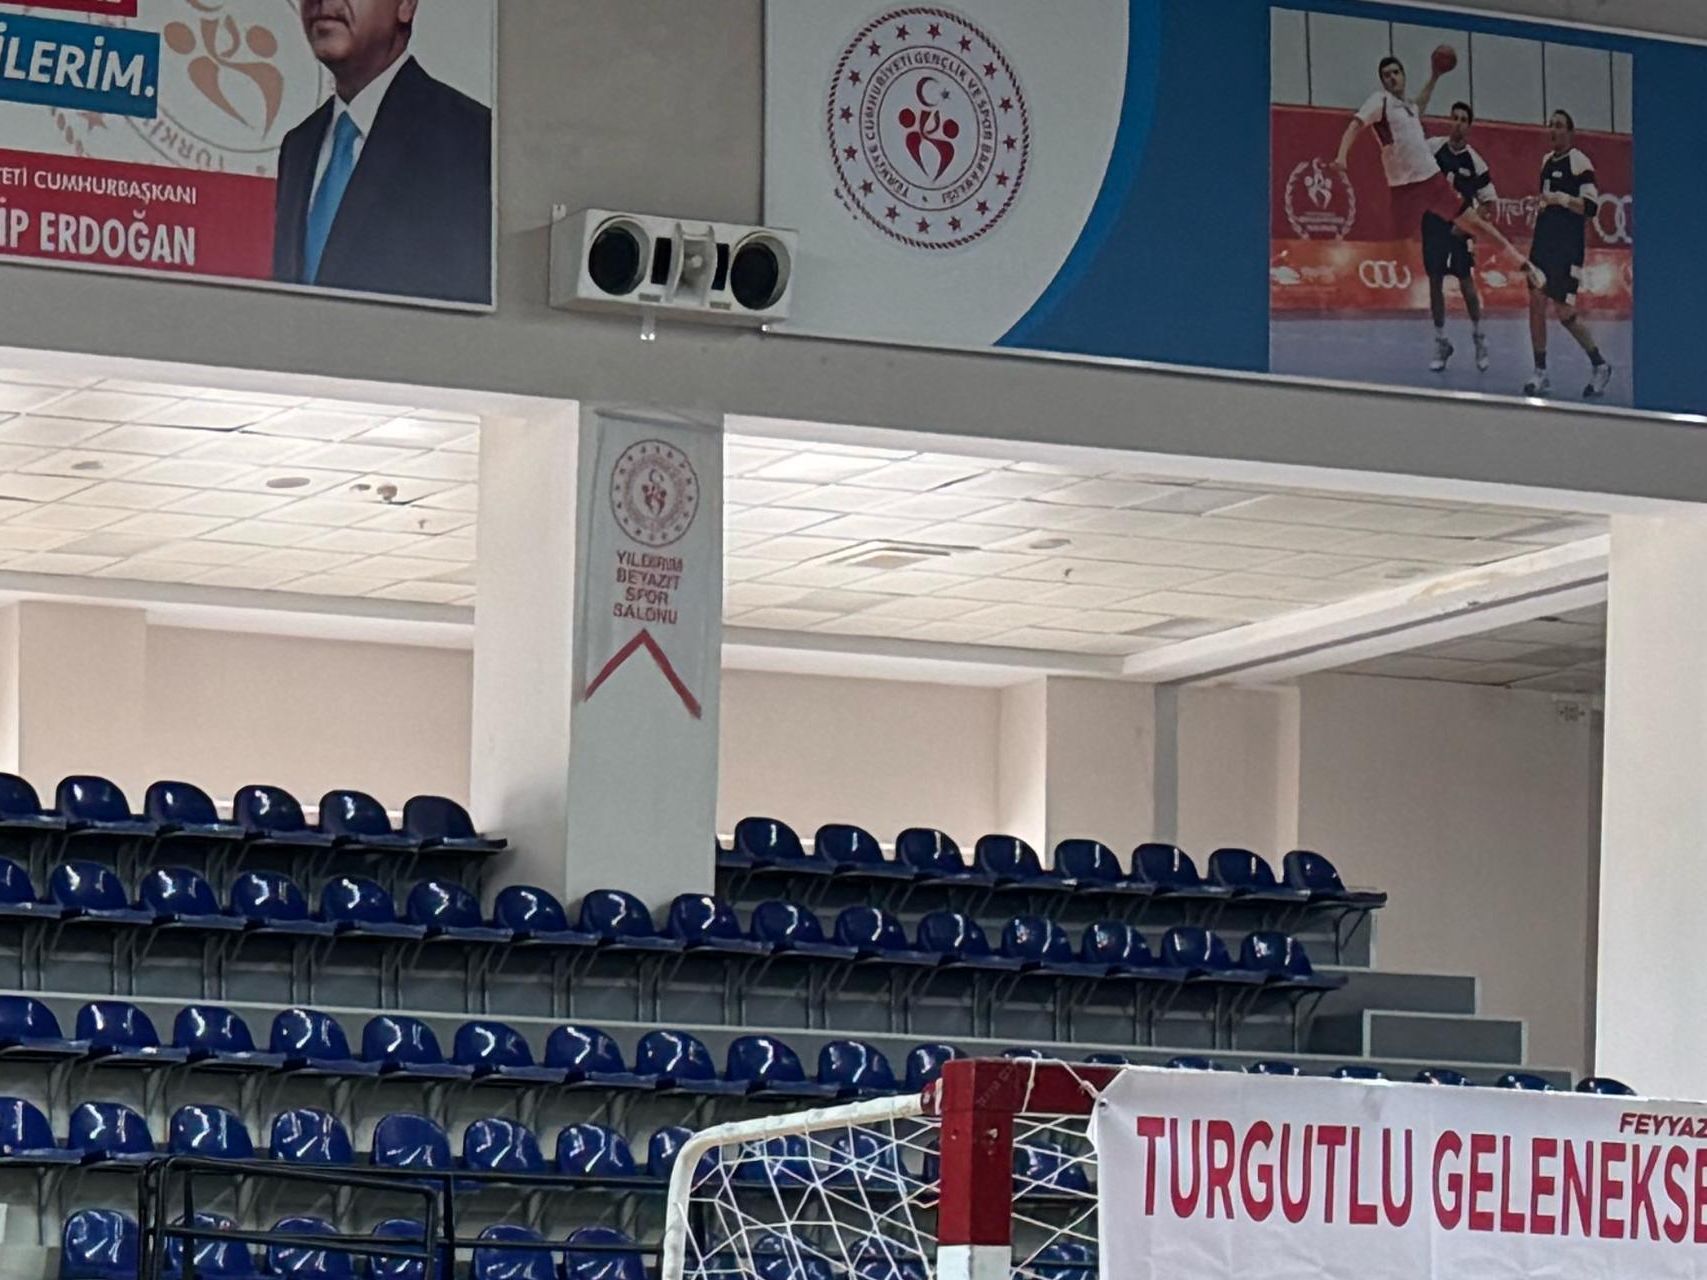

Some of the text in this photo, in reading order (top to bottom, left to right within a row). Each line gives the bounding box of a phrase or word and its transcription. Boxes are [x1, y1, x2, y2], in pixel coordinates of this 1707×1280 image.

[33, 170, 198, 205] CUMHURBAŞKANI
[39, 208, 196, 266] ERDOĞAN
[625, 587, 669, 606] SPOR
[613, 602, 678, 624] SALONU
[1619, 1112, 1707, 1138] FEYYAZ
[1136, 1115, 1414, 1227] TURGUTLU
